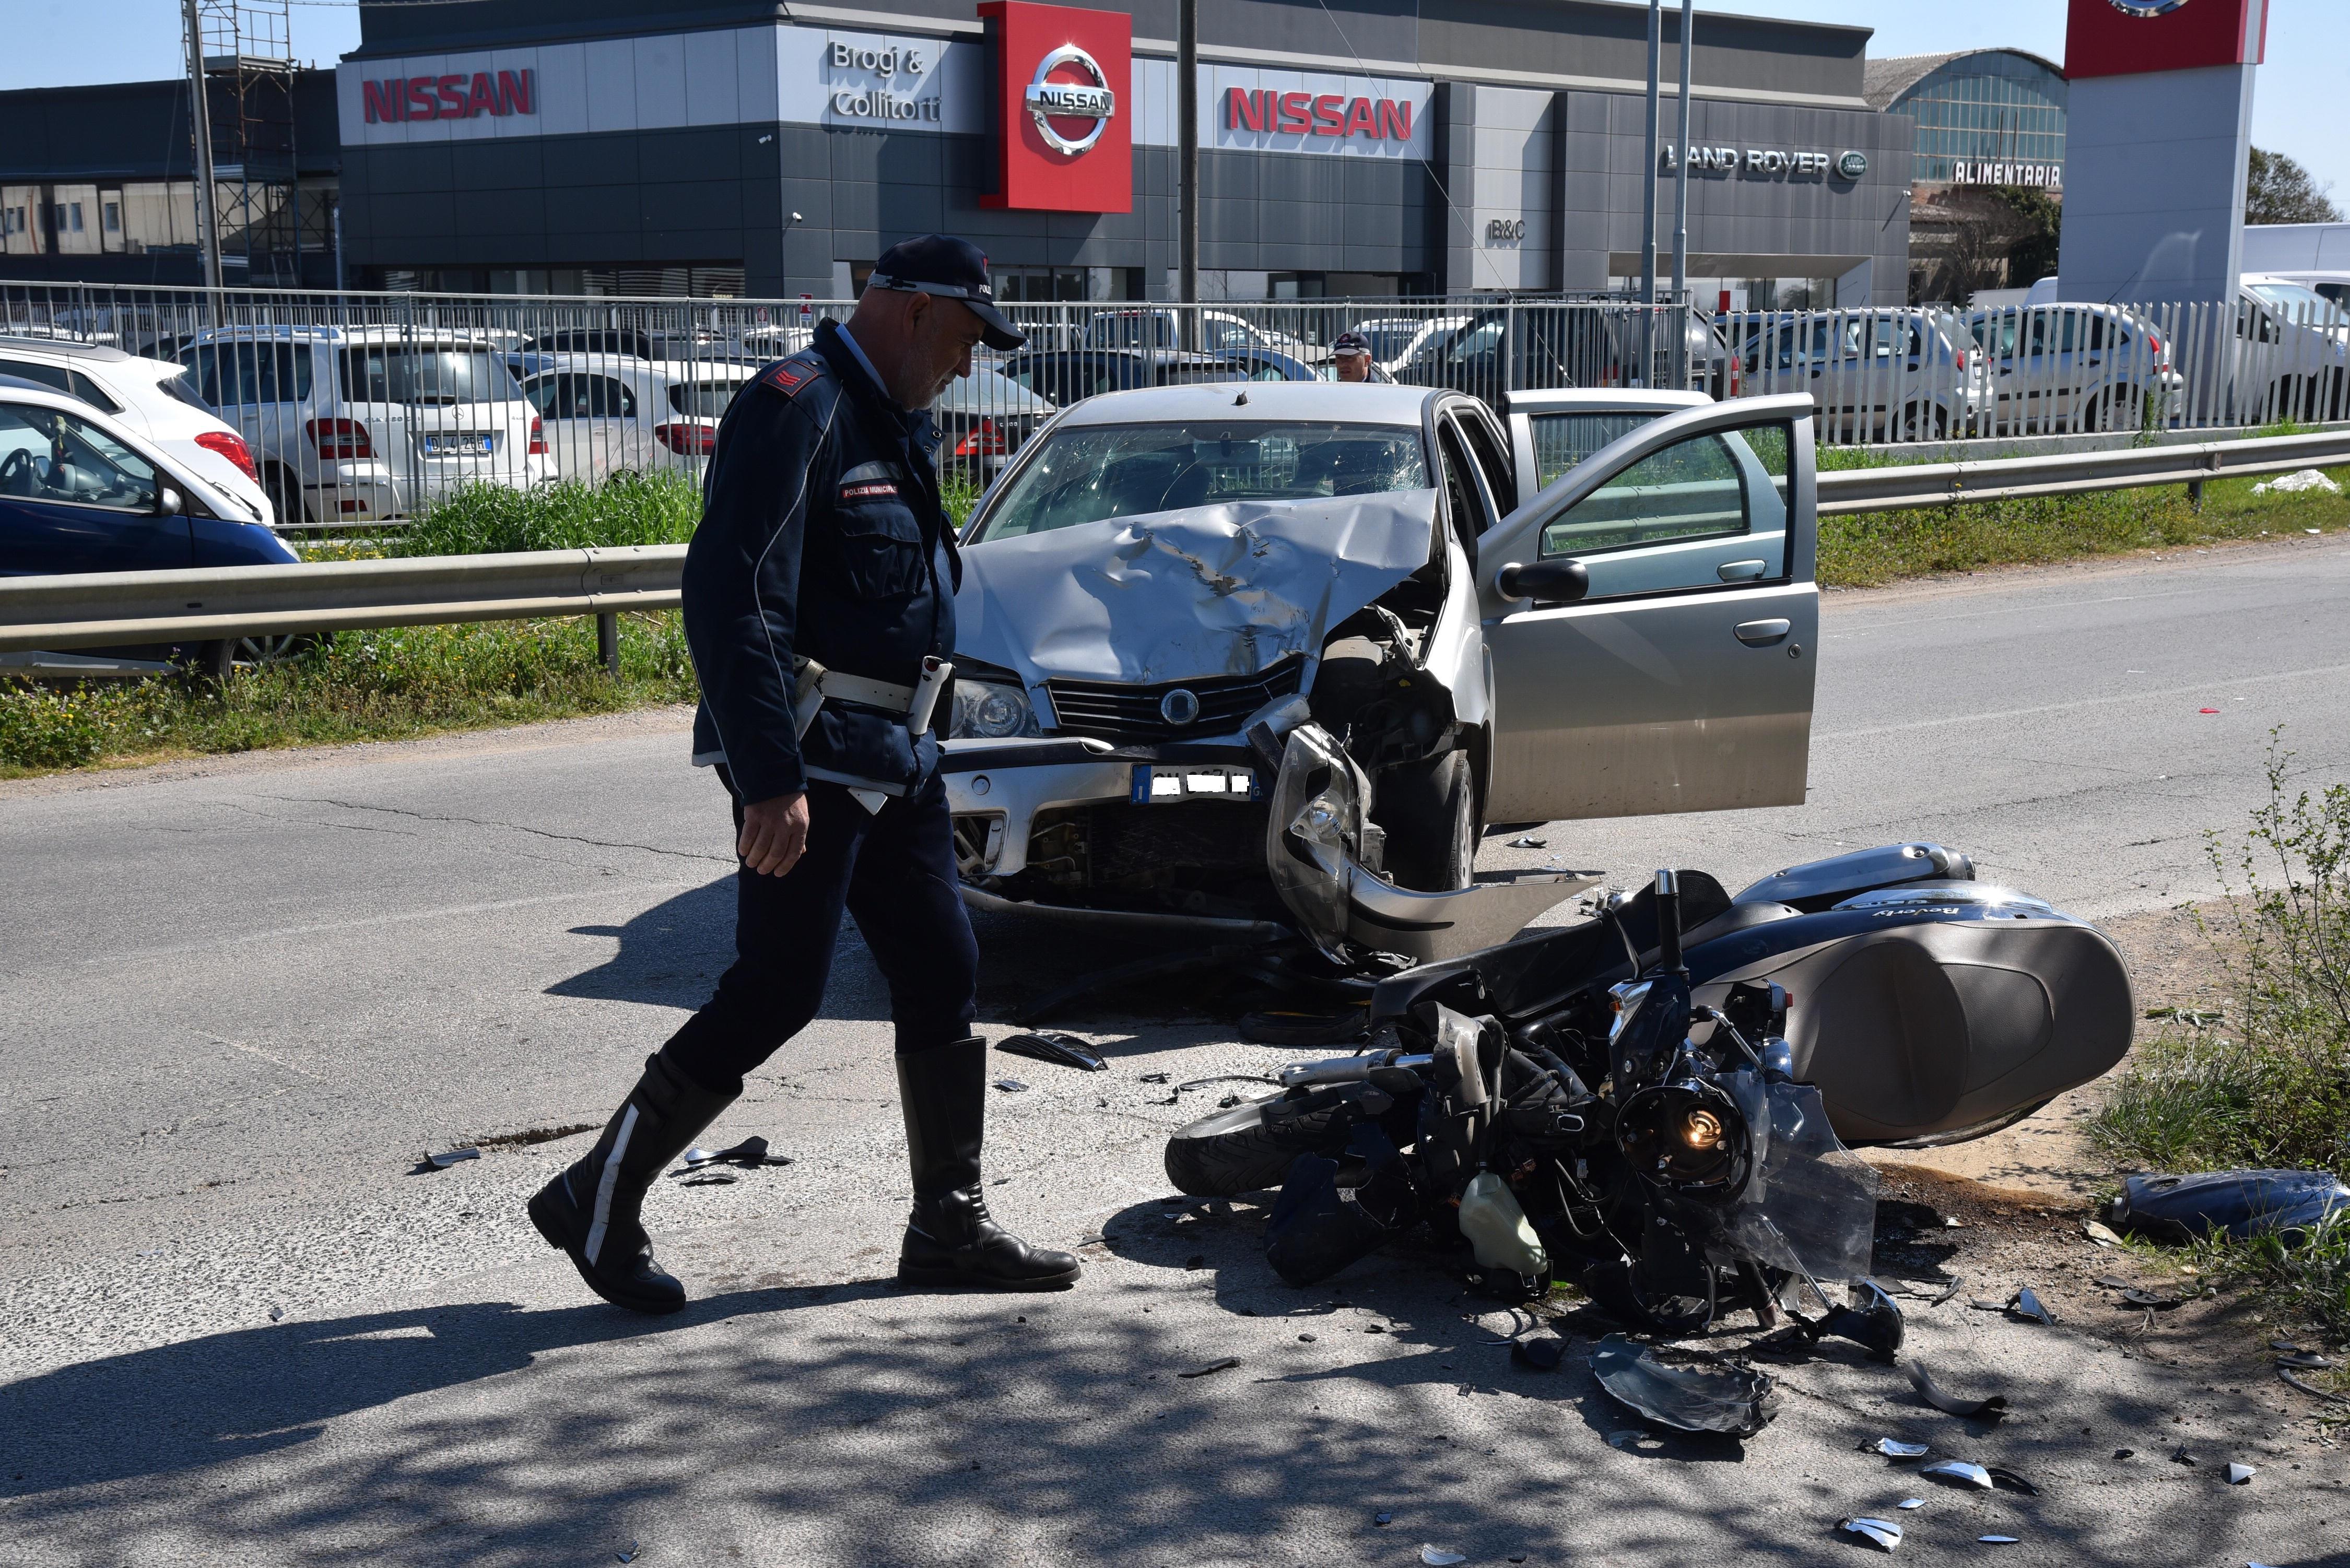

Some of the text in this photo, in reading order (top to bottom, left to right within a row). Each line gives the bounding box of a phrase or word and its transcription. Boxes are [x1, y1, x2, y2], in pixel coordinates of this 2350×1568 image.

[830, 41, 925, 78] Brogi &
[363, 68, 533, 123] NISSAN
[832, 89, 942, 121] Collitorti
[1039, 90, 1111, 111] NISSAN
[1226, 87, 1412, 140] NISSAN
[1666, 145, 1830, 174] LAND ROVER
[1955, 162, 2061, 186] ALIMENTARIA
[1489, 219, 1525, 240] B&C
[844, 487, 869, 497] POLIZIA
[1871, 907, 1959, 917] Beverly
